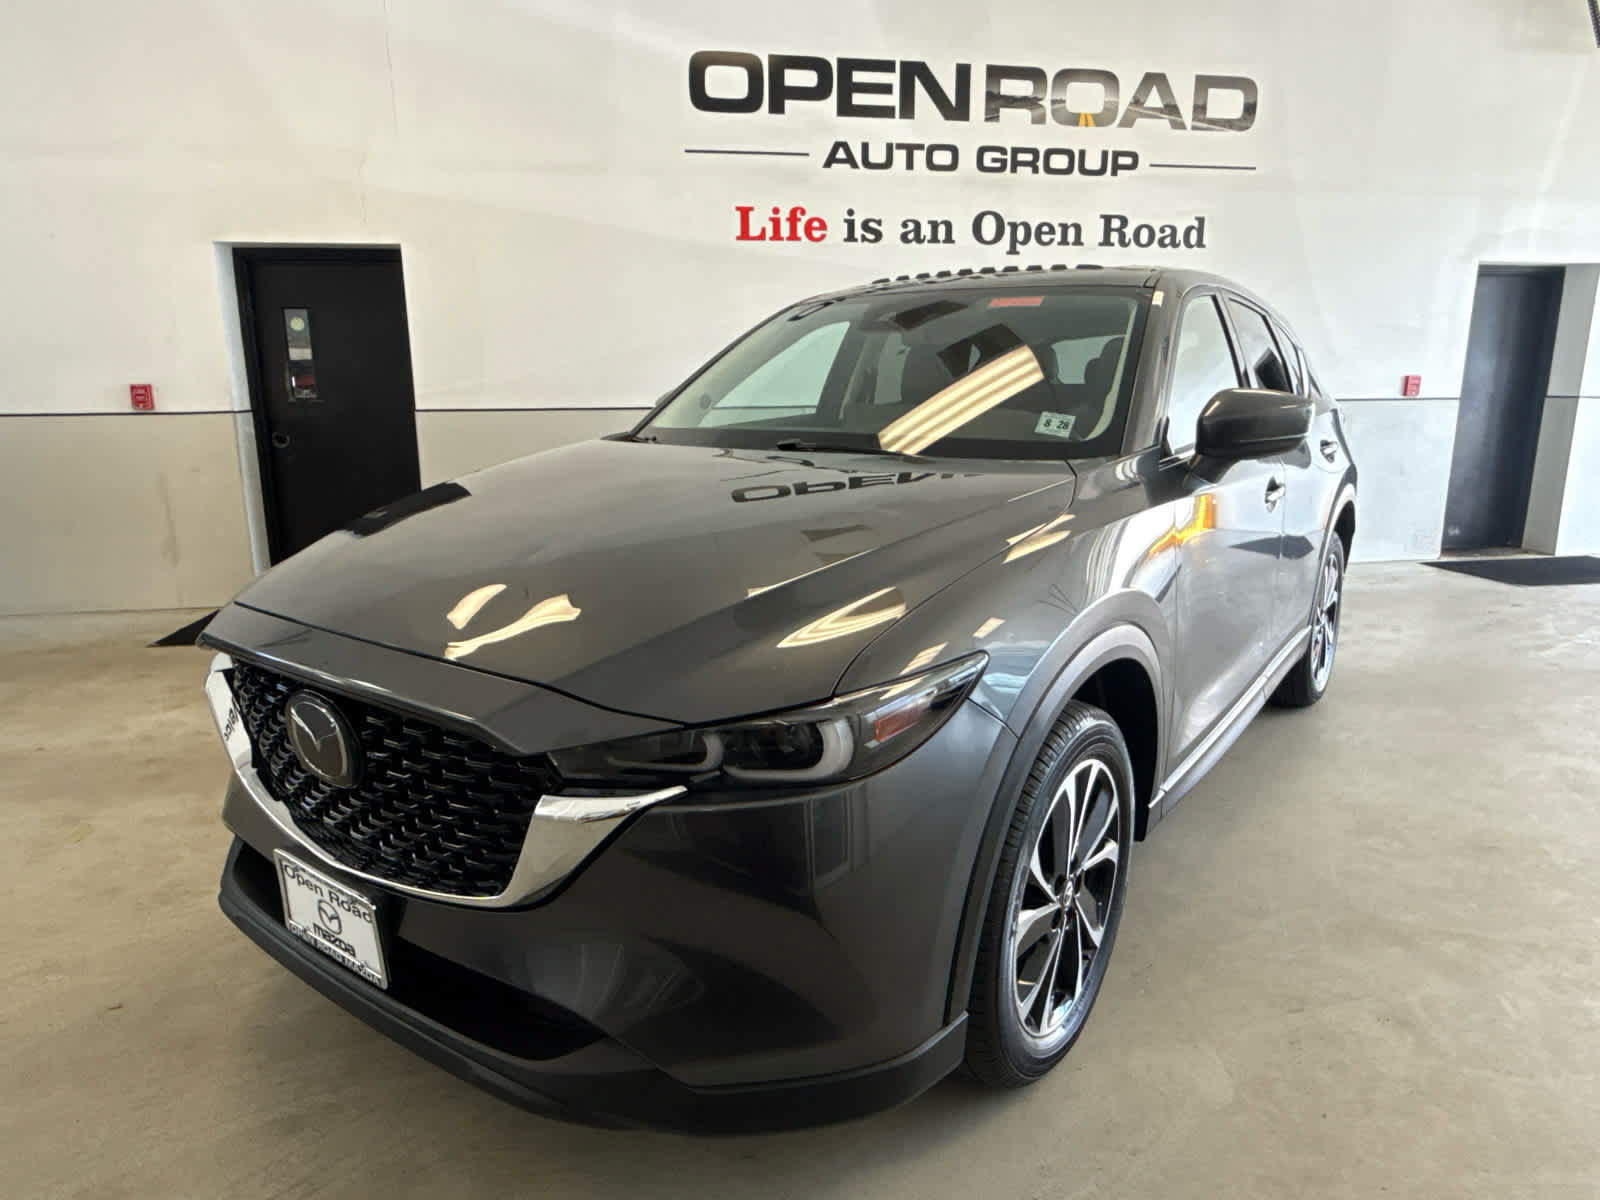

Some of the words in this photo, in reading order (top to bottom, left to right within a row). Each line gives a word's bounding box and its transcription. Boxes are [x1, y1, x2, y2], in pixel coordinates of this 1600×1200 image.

[688, 50, 972, 122] OPEN
[983, 63, 1258, 132] ROAD
[822, 140, 960, 172] AUTO
[975, 145, 1140, 177] GROUP
[735, 205, 828, 243] Life
[842, 208, 884, 244] is
[899, 217, 956, 245] an
[971, 210, 1085, 256] Open
[1098, 214, 1206, 249] Road
[284, 864, 323, 897] Open
